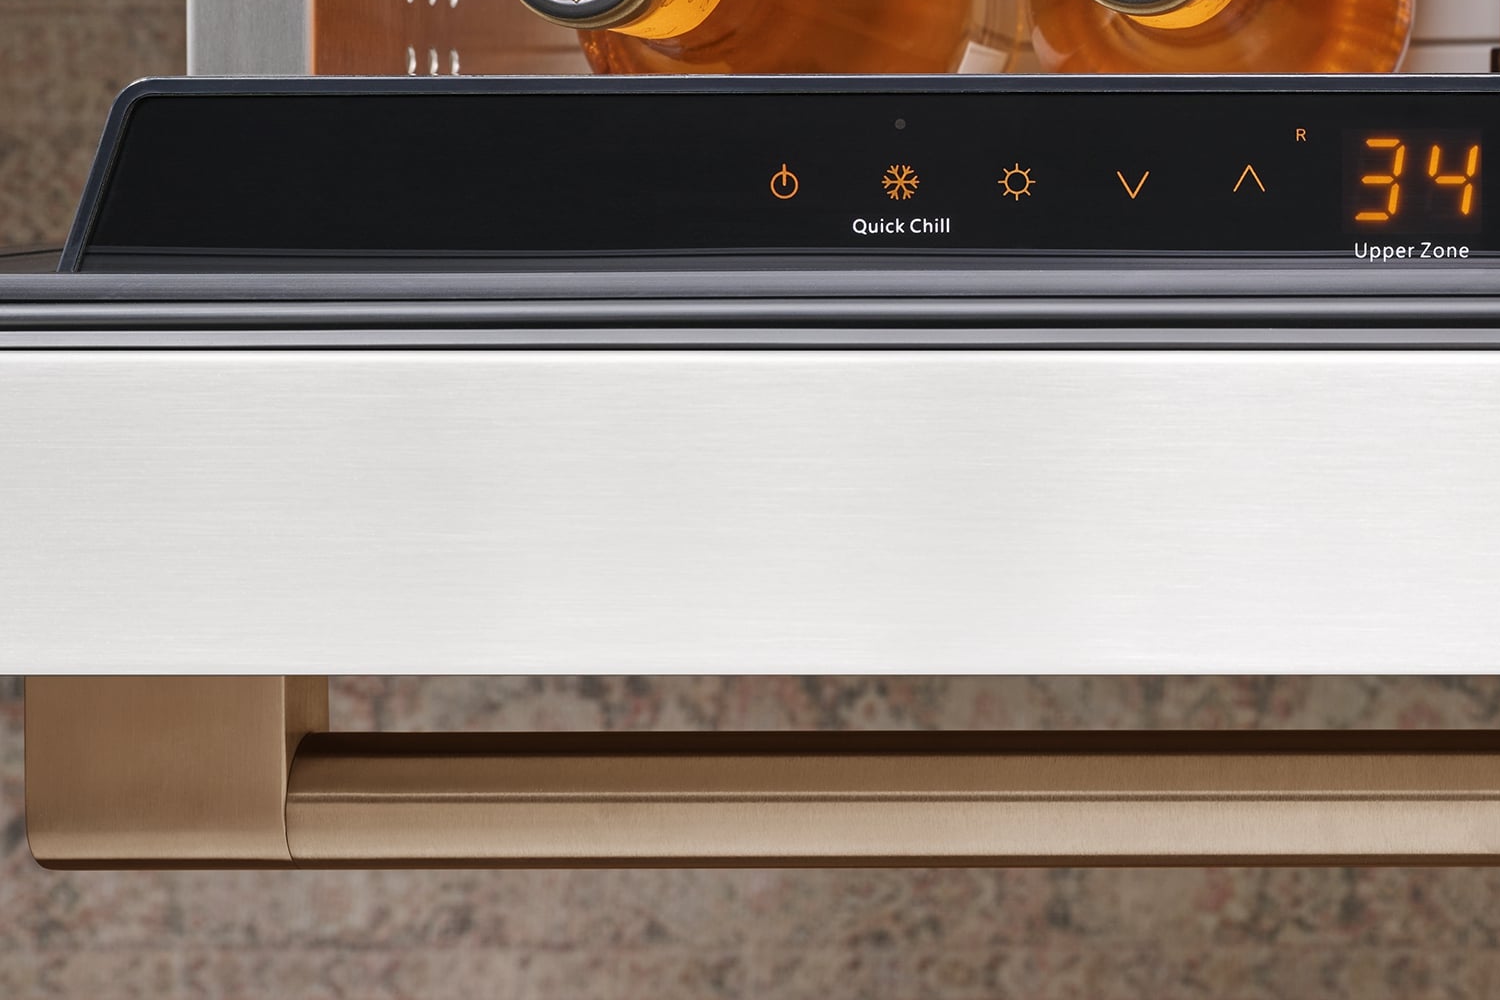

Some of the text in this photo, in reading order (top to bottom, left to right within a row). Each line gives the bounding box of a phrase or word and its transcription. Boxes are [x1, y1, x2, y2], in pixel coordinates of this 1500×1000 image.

[1295, 128, 1307, 142] R
[1354, 138, 1479, 222] 34
[852, 217, 951, 236] Quick Chill
[1354, 241, 1470, 263] Upper Zone
